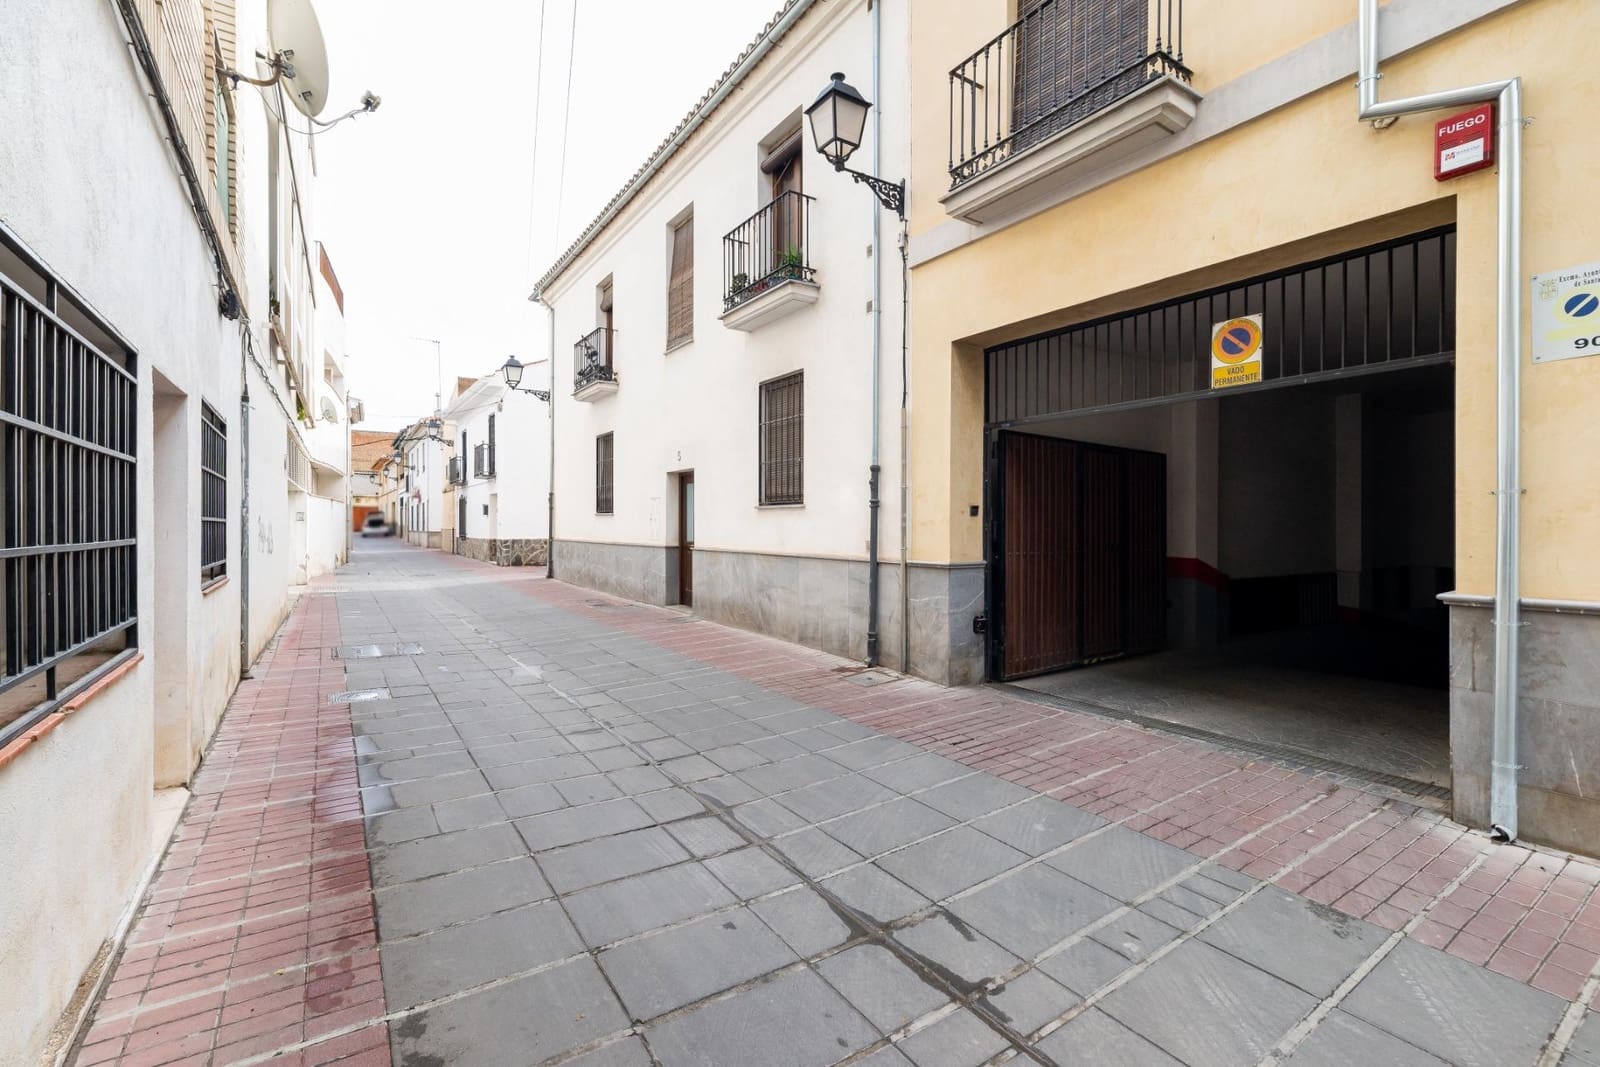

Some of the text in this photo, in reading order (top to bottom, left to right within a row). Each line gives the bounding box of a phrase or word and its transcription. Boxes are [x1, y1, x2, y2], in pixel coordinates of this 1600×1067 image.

[1439, 114, 1486, 137] FUEGO
[1574, 280, 1582, 288] de
[1226, 366, 1245, 376] VADO
[1214, 372, 1258, 387] PERMANENTE
[677, 450, 682, 462] 5
